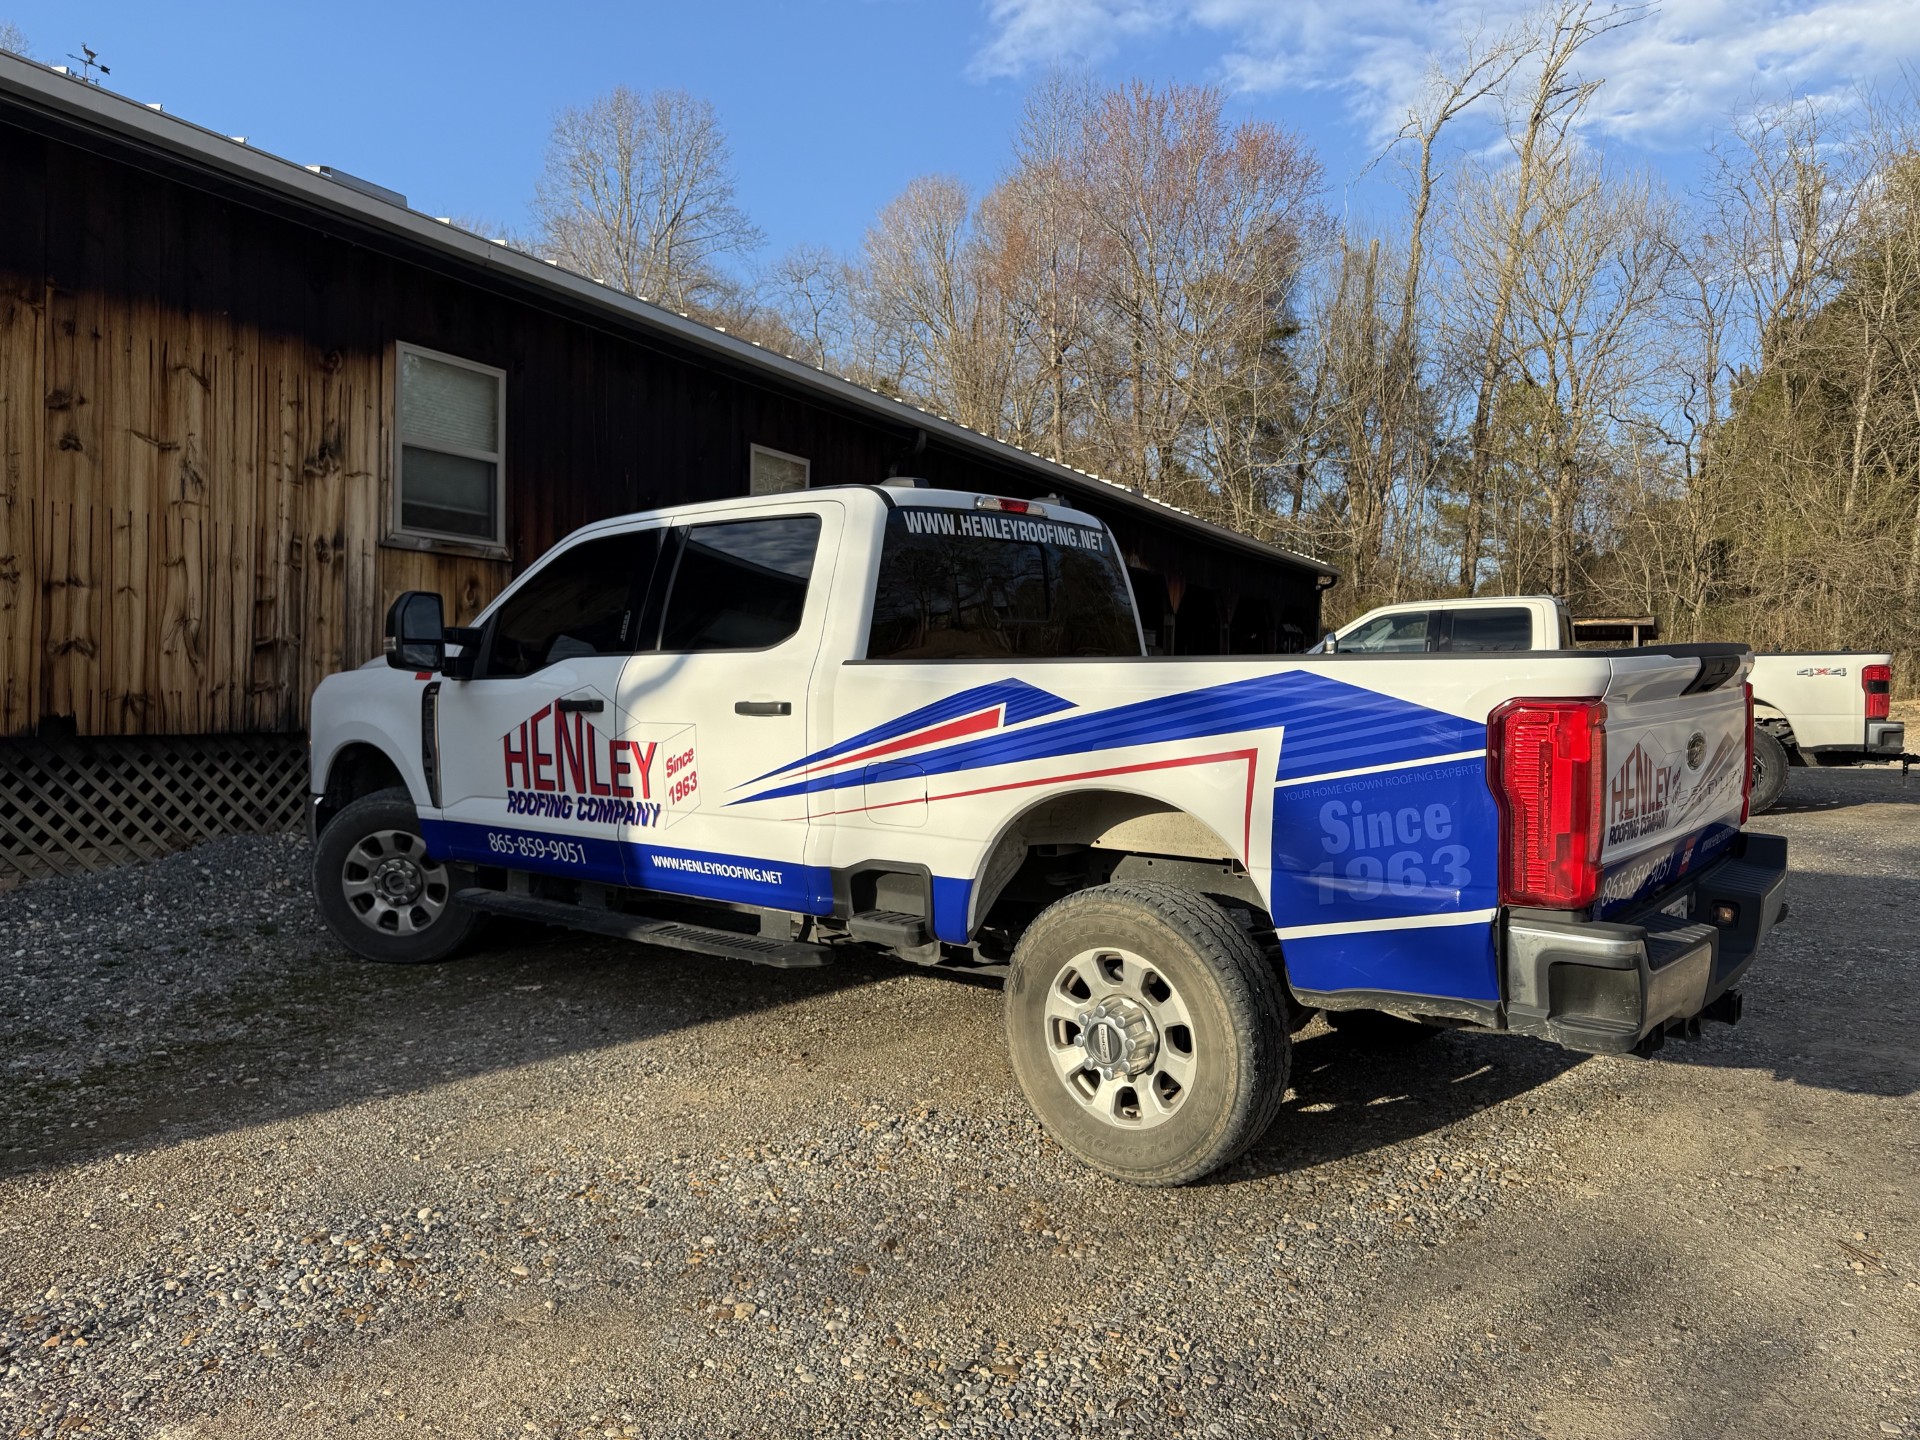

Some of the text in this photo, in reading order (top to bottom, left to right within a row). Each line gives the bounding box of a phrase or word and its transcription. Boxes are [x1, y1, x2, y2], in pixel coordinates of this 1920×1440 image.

[902, 511, 1103, 551] WWW.HENLEYROOFING.NET
[504, 697, 658, 799] HENLEY
[666, 747, 694, 779] Since
[668, 771, 698, 806] 1963
[1283, 763, 1482, 801] YOUR HOME GROWN ROOFING EXPERTS
[1610, 741, 1672, 826] HENLEY
[507, 790, 661, 828] ROOFING COMPANY
[1319, 799, 1452, 855] Since
[488, 832, 587, 865] 865-859-9051
[1608, 817, 1640, 847] ROOFING
[651, 855, 783, 885] WWW.HENLEYROOFING.NET
[1309, 844, 1472, 906] 1963
